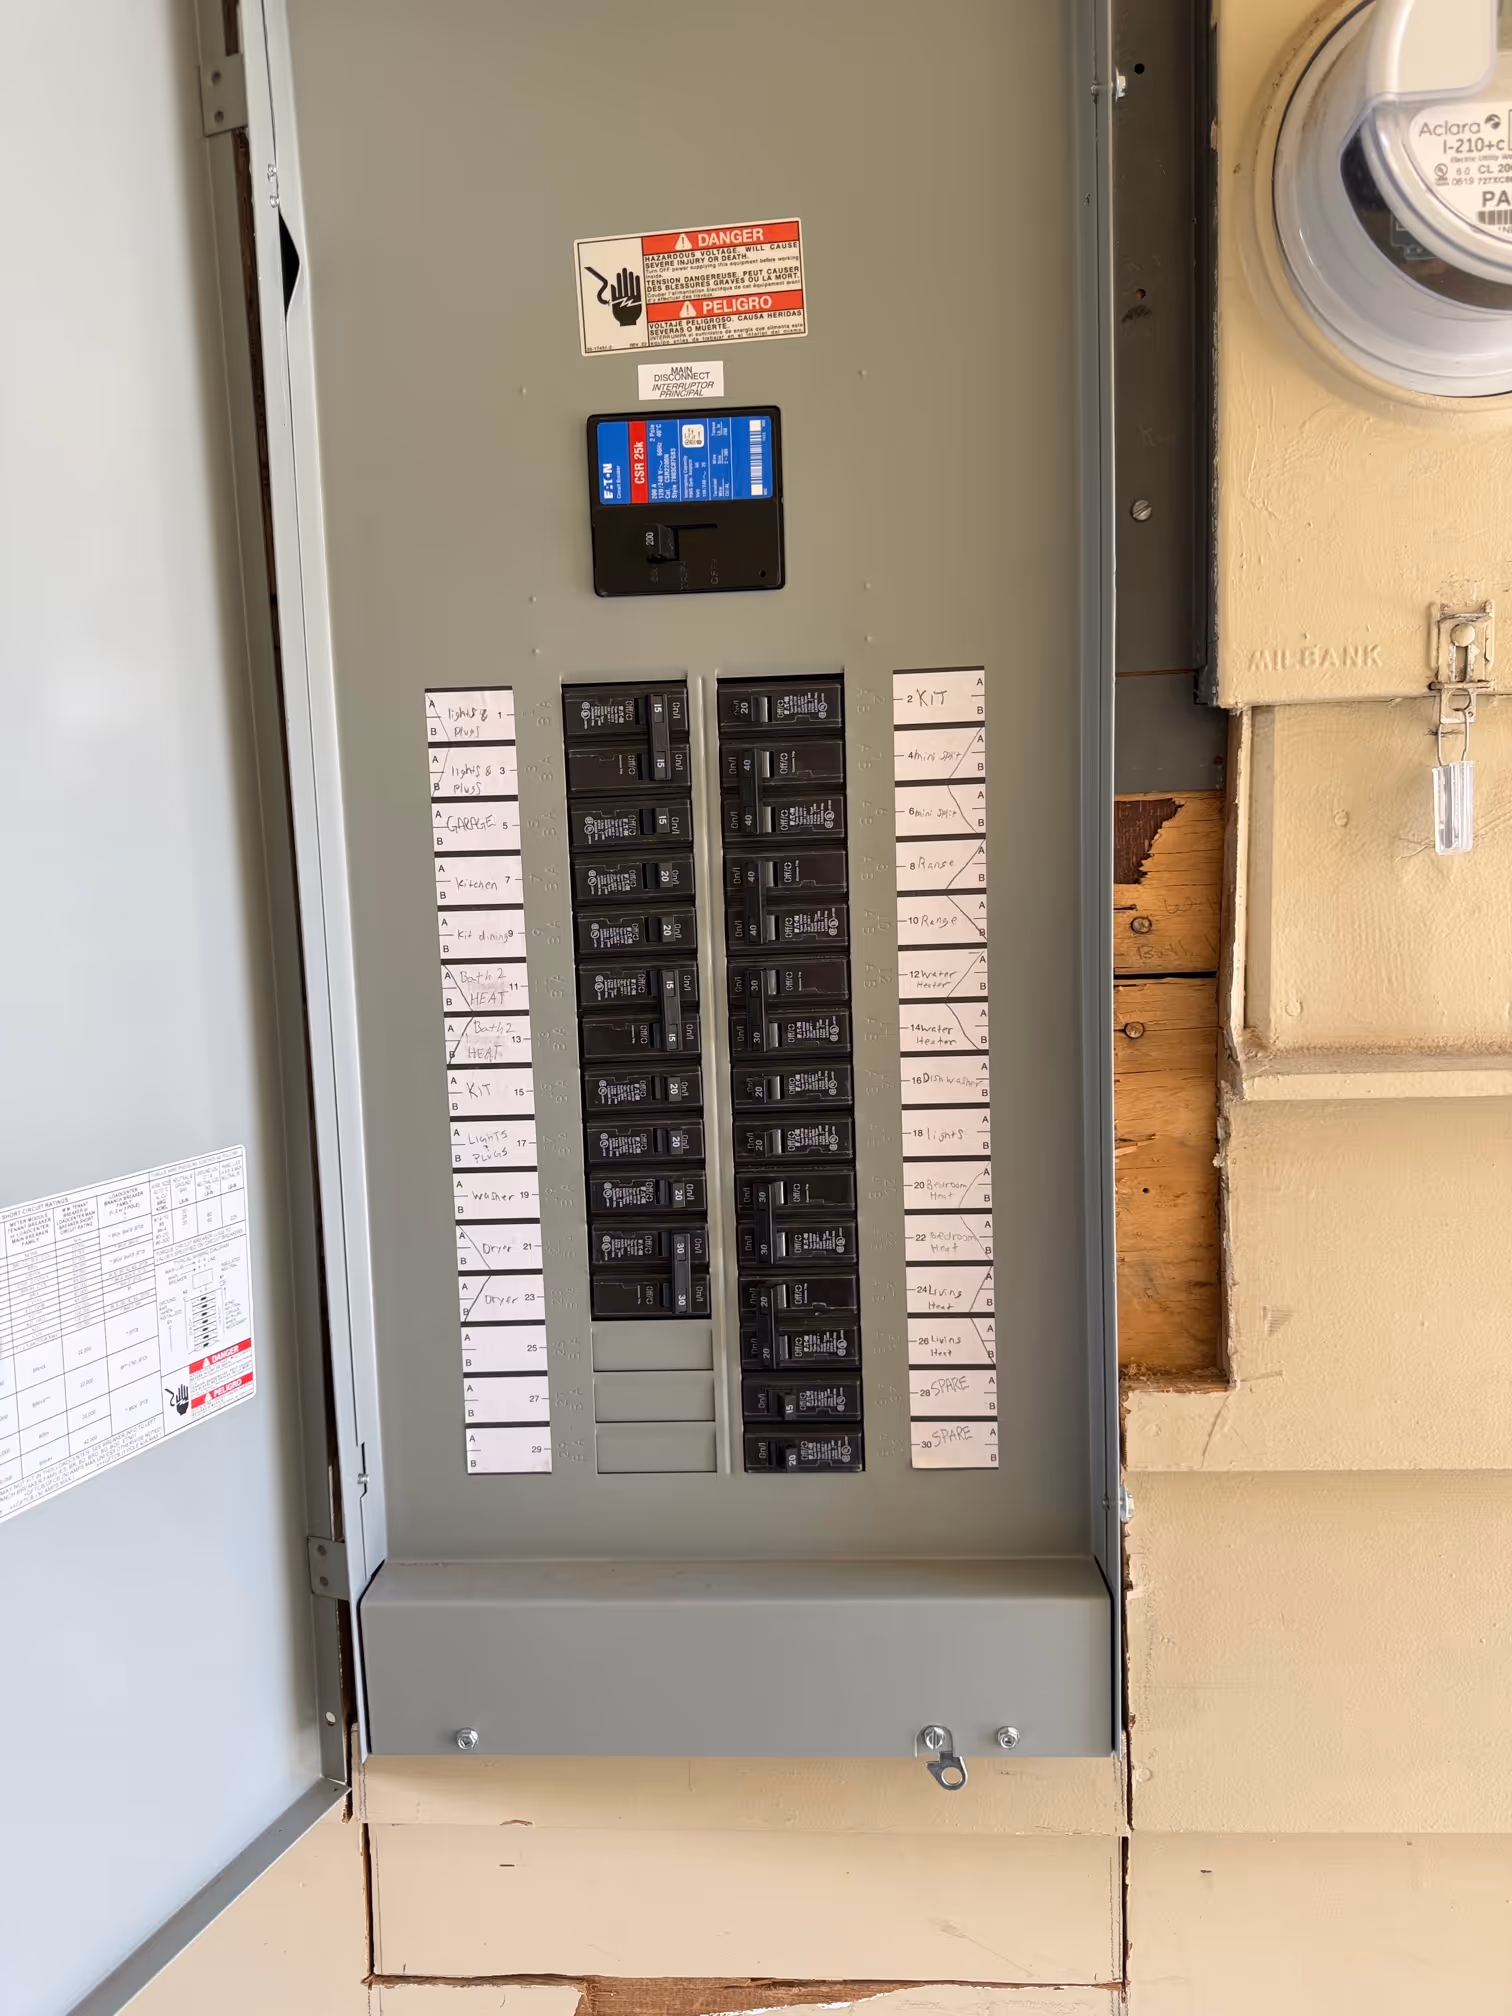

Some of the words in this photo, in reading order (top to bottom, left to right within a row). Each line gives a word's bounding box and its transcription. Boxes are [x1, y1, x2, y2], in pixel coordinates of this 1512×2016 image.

[1418, 120, 1481, 137] Aclara
[1478, 164, 1494, 174] CL
[1498, 163, 1512, 173] 20
[698, 228, 764, 247] DANGER
[645, 252, 696, 262] HAZARDOUS
[700, 248, 740, 257] VOLTAGE.
[770, 242, 798, 250] CAUSE
[646, 261, 674, 269] SEVERE
[678, 257, 705, 266] INJURY
[722, 253, 749, 261] DEATH.
[647, 277, 680, 286] TENSION
[684, 272, 739, 282] DANGEREUSE.
[767, 266, 799, 274] CAUSER
[665, 281, 710, 290] BLESSURES
[714, 277, 745, 286] GRAVES
[703, 296, 772, 315] PELIGRO
[649, 320, 683, 329] VOLTAJE
[686, 316, 734, 326] PELIGROSO.
[768, 310, 802, 318] HERIDAS
[650, 327, 684, 336] SEVERAS
[695, 323, 729, 331] MUERTE.
[671, 366, 692, 374] MAIN
[654, 372, 710, 382] DISCONNECT
[652, 381, 714, 391] INTERRUPTOR
[660, 389, 703, 398] PRINCIPAL
[633, 441, 644, 460] 25k
[634, 463, 645, 484] CSR
[646, 532, 654, 545] 200
[1248, 644, 1383, 672] MILBANK
[976, 678, 983, 686] A
[907, 695, 913, 703] 2
[916, 688, 948, 707] KIT
[654, 704, 662, 713] 15
[740, 702, 748, 714] 20
[977, 706, 983, 714] B
[744, 760, 751, 771] 40
[909, 808, 914, 816] 6
[447, 814, 496, 834] GARAGE
[659, 815, 667, 824] 15
[910, 862, 915, 870] 8
[661, 870, 669, 882] 20
[748, 871, 755, 882] 40
[497, 968, 506, 979] 2
[751, 980, 758, 991] 30
[470, 990, 509, 1006] HEAT
[506, 1023, 516, 1033] 2
[468, 1044, 502, 1062] HEAT
[514, 1088, 524, 1096] 15
[108, 1188, 138, 1199] LOADCENTER
[1, 1211, 21, 1220] SHORT
[22, 1205, 43, 1214] CIRCUIT
[45, 1198, 69, 1208] RATINGS
[677, 1243, 685, 1254] 30
[211, 1346, 239, 1363] DANGER
[212, 1379, 242, 1398] PELIGRO
[930, 1376, 969, 1396] SPARE
[786, 1404, 793, 1413] 15
[932, 1426, 973, 1447] SPARE
[789, 1454, 796, 1466] 20
